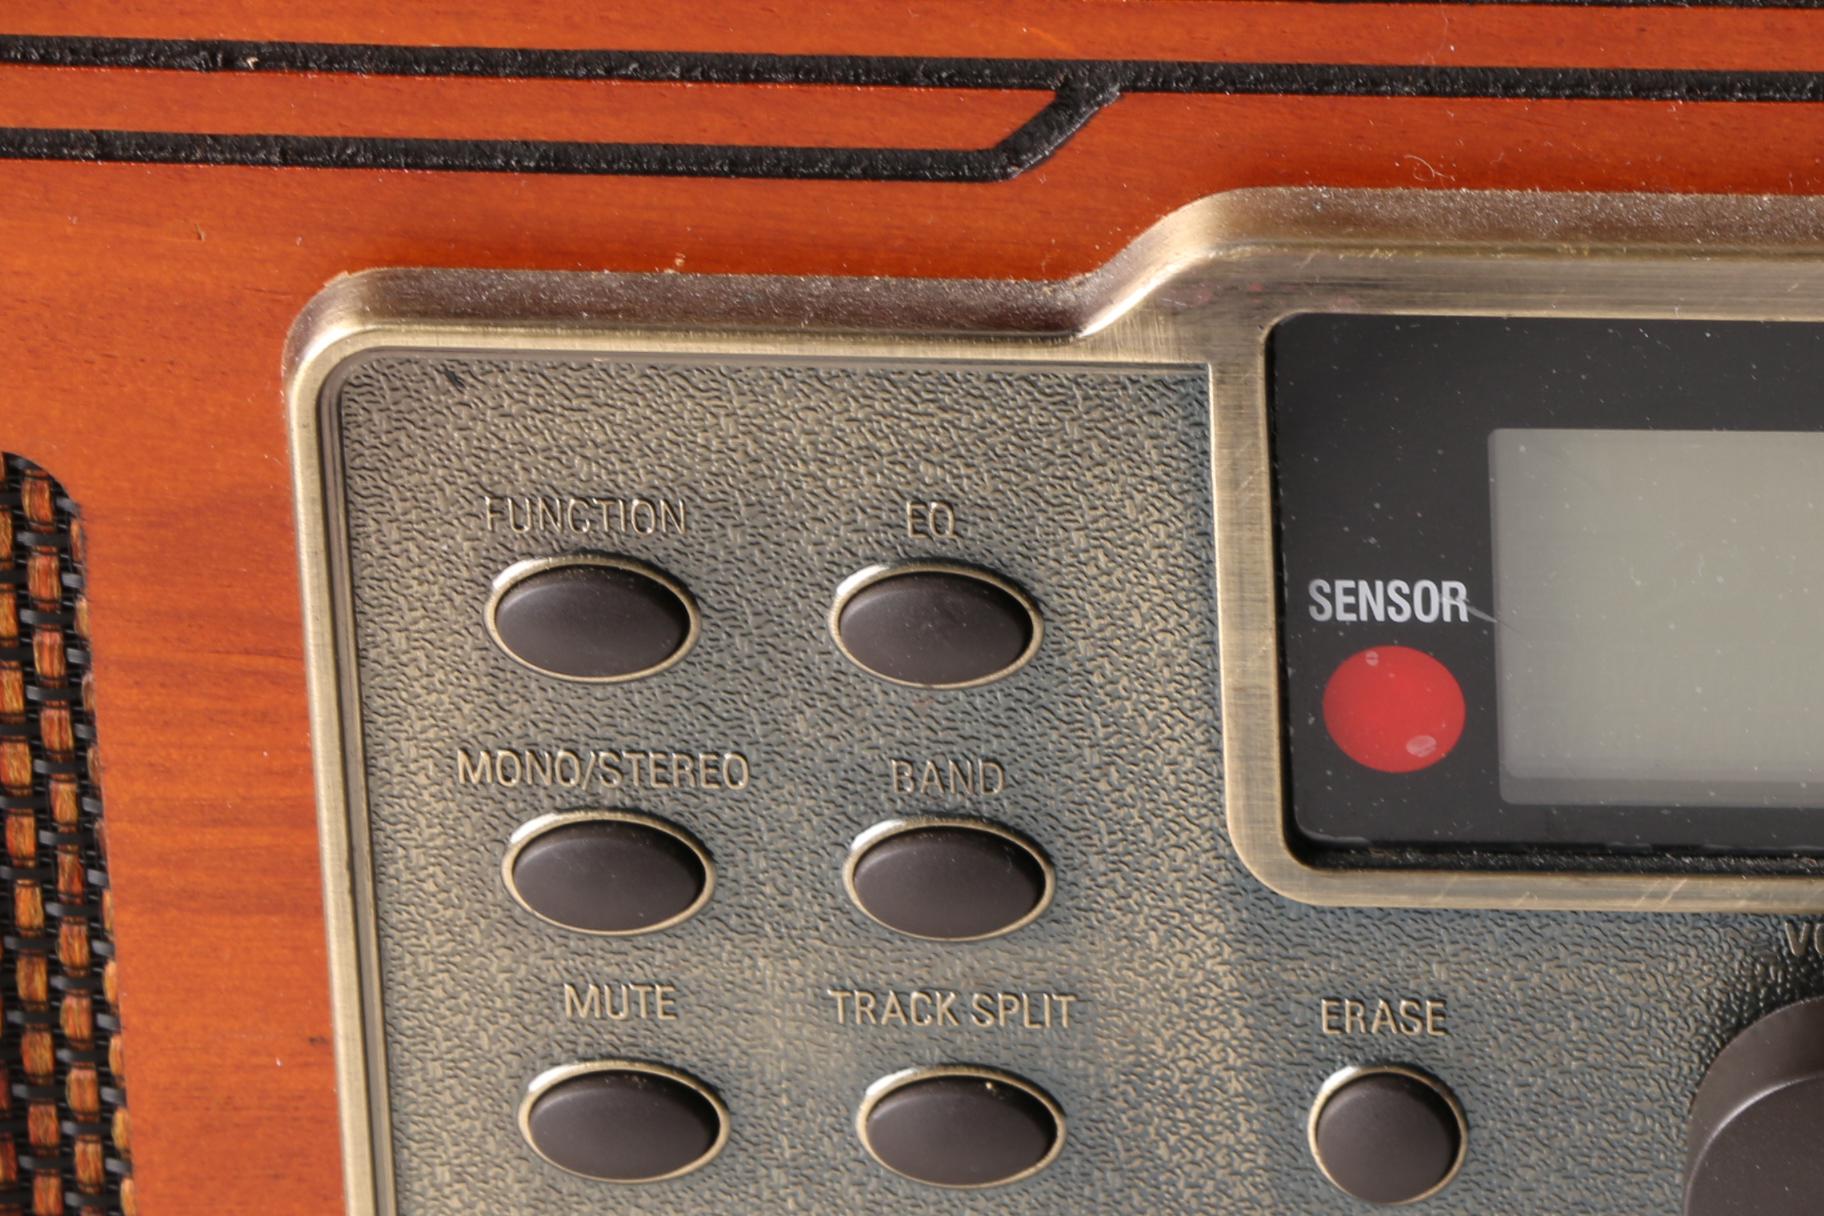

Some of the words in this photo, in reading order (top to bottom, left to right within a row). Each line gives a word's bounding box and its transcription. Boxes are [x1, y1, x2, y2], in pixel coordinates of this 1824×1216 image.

[485, 496, 687, 536] FUNCTION
[906, 502, 955, 538] EQ
[1307, 579, 1470, 624] SENSOR
[457, 750, 751, 790] MONO/STEREO
[891, 758, 1004, 794] BAND
[564, 983, 678, 1022] MUTE
[827, 989, 959, 1026] TRACK
[970, 992, 1076, 1030] SPLIT
[1321, 999, 1446, 1036] ERASE
